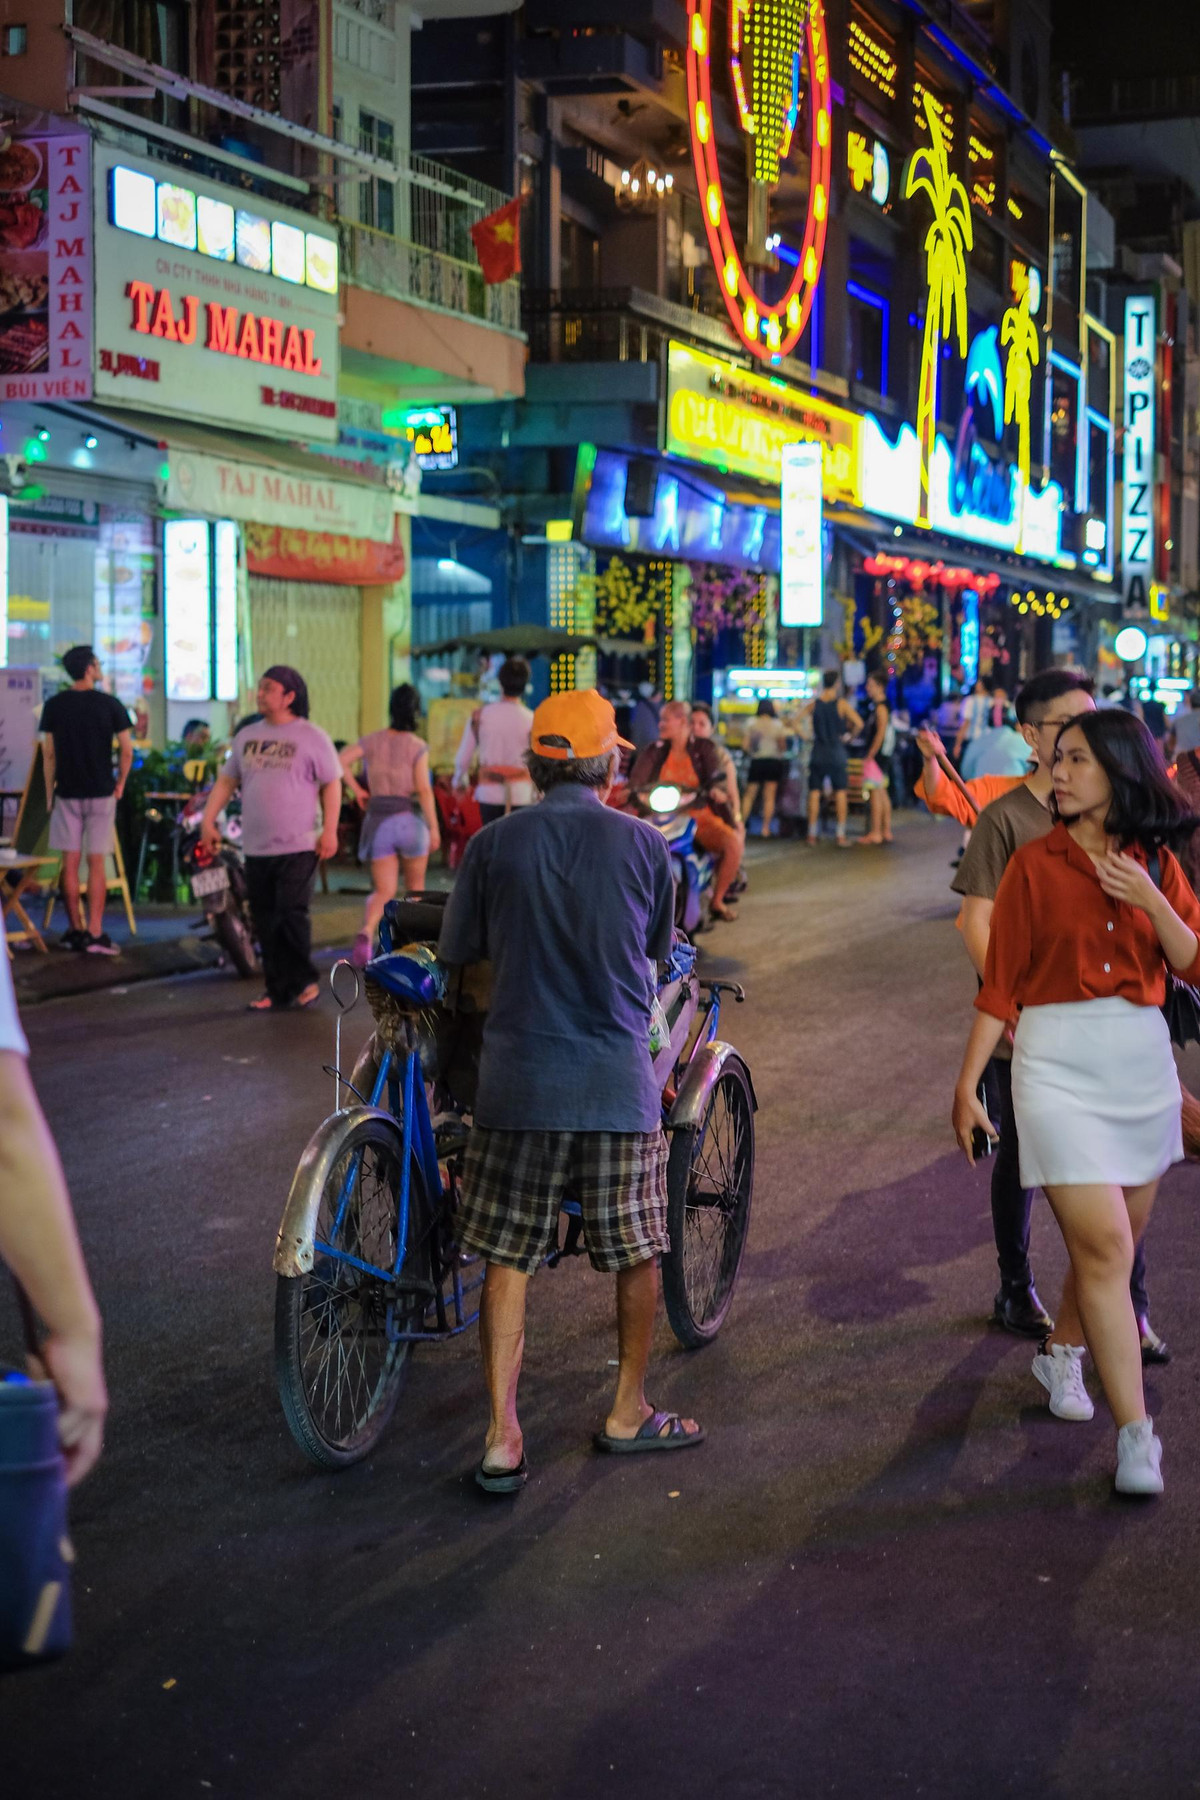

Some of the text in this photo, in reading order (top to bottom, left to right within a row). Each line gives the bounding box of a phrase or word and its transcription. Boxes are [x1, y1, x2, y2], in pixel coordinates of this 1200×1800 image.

[55, 146, 84, 367] TAJ MAHAL
[127, 280, 199, 344] TAJ
[206, 302, 322, 376] MAHAL
[218, 466, 339, 511] TAJ MAHAL
